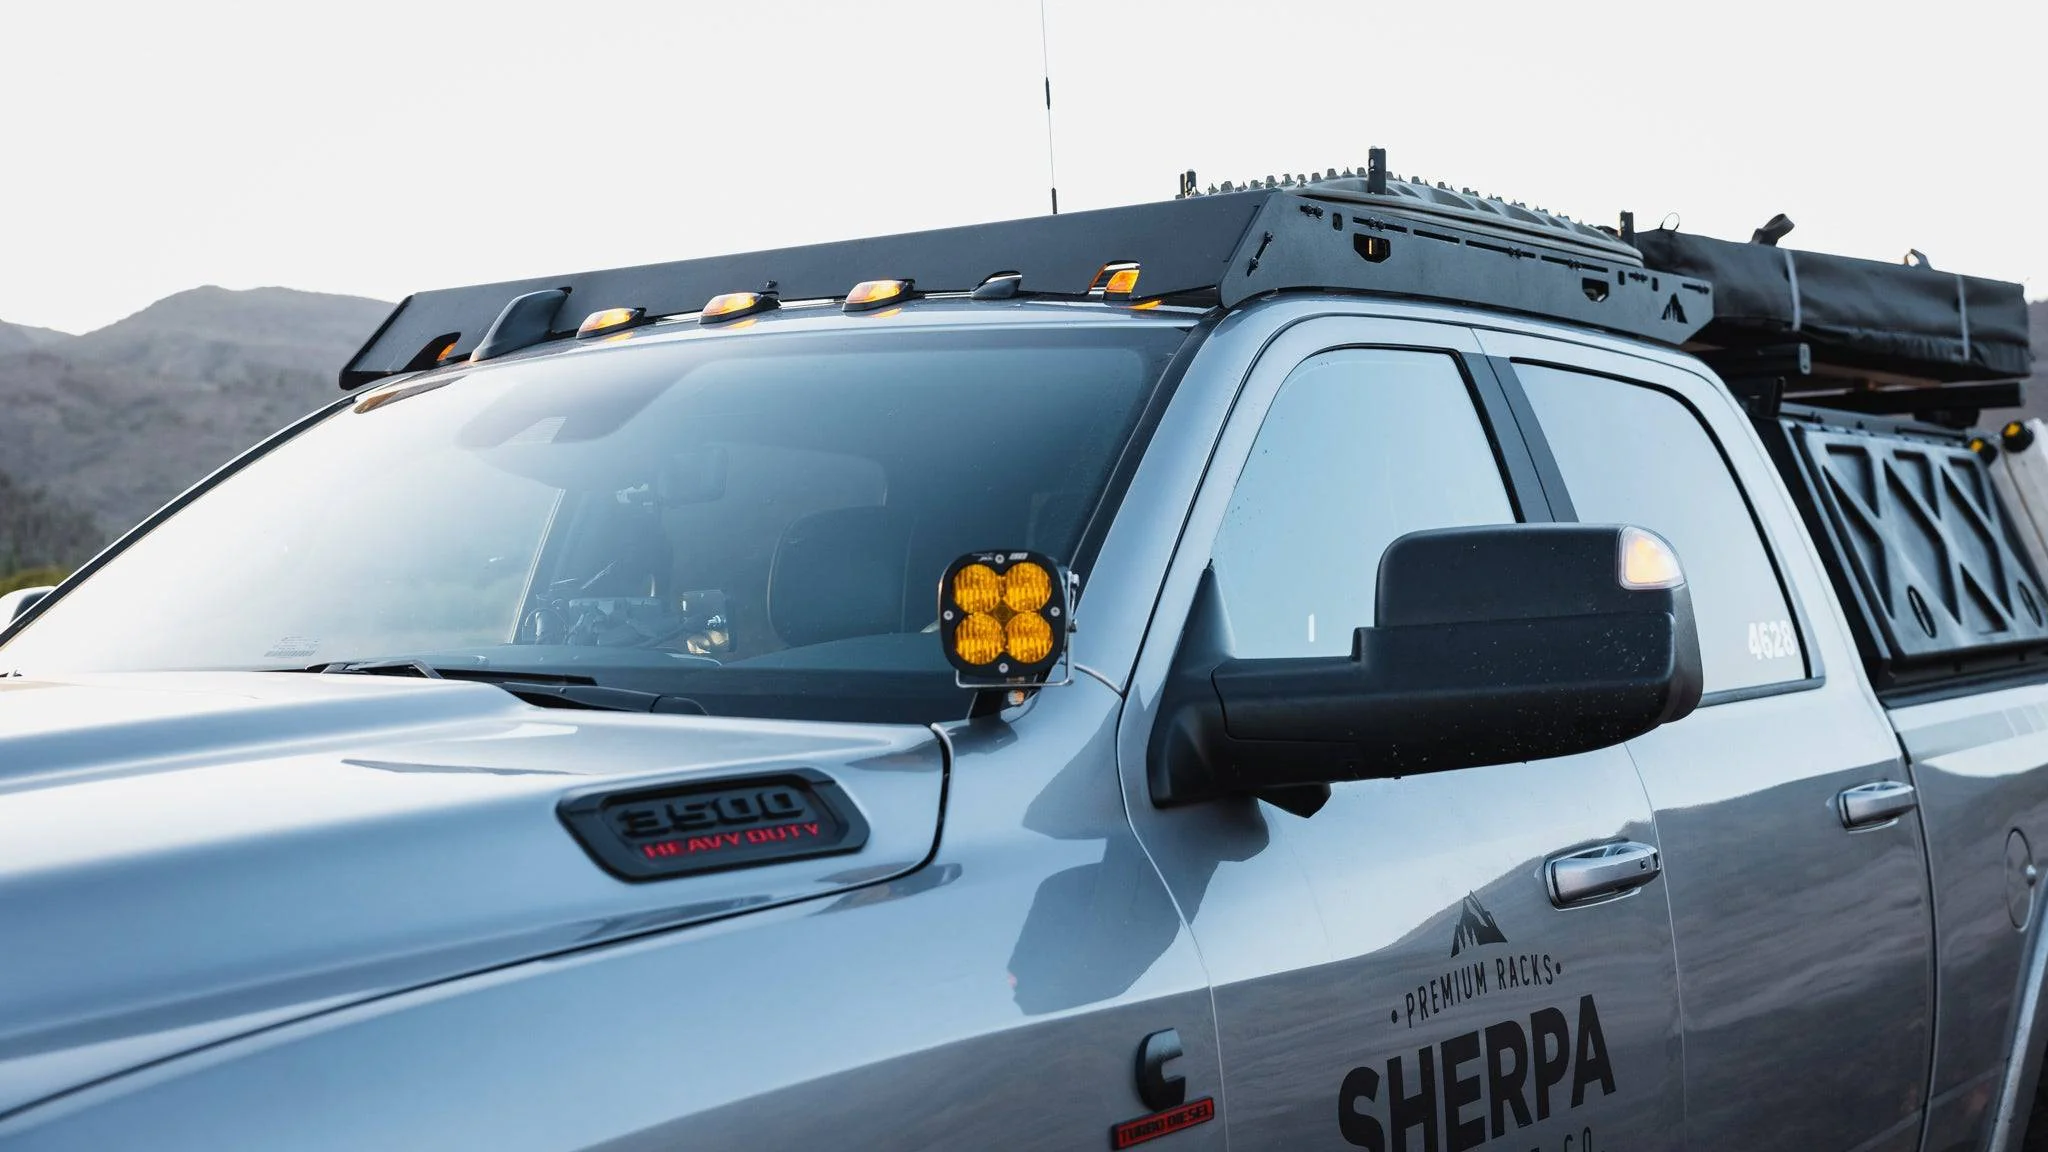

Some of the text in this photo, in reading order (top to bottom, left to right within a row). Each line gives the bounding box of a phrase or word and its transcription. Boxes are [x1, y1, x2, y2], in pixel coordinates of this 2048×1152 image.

[1748, 619, 1796, 660] 4628
[617, 788, 806, 838] 3500
[642, 823, 820, 859] HEAVY DUTY
[1405, 954, 1554, 1028] PREMIUM RACKS
[1338, 994, 1617, 1152] SHERPA
